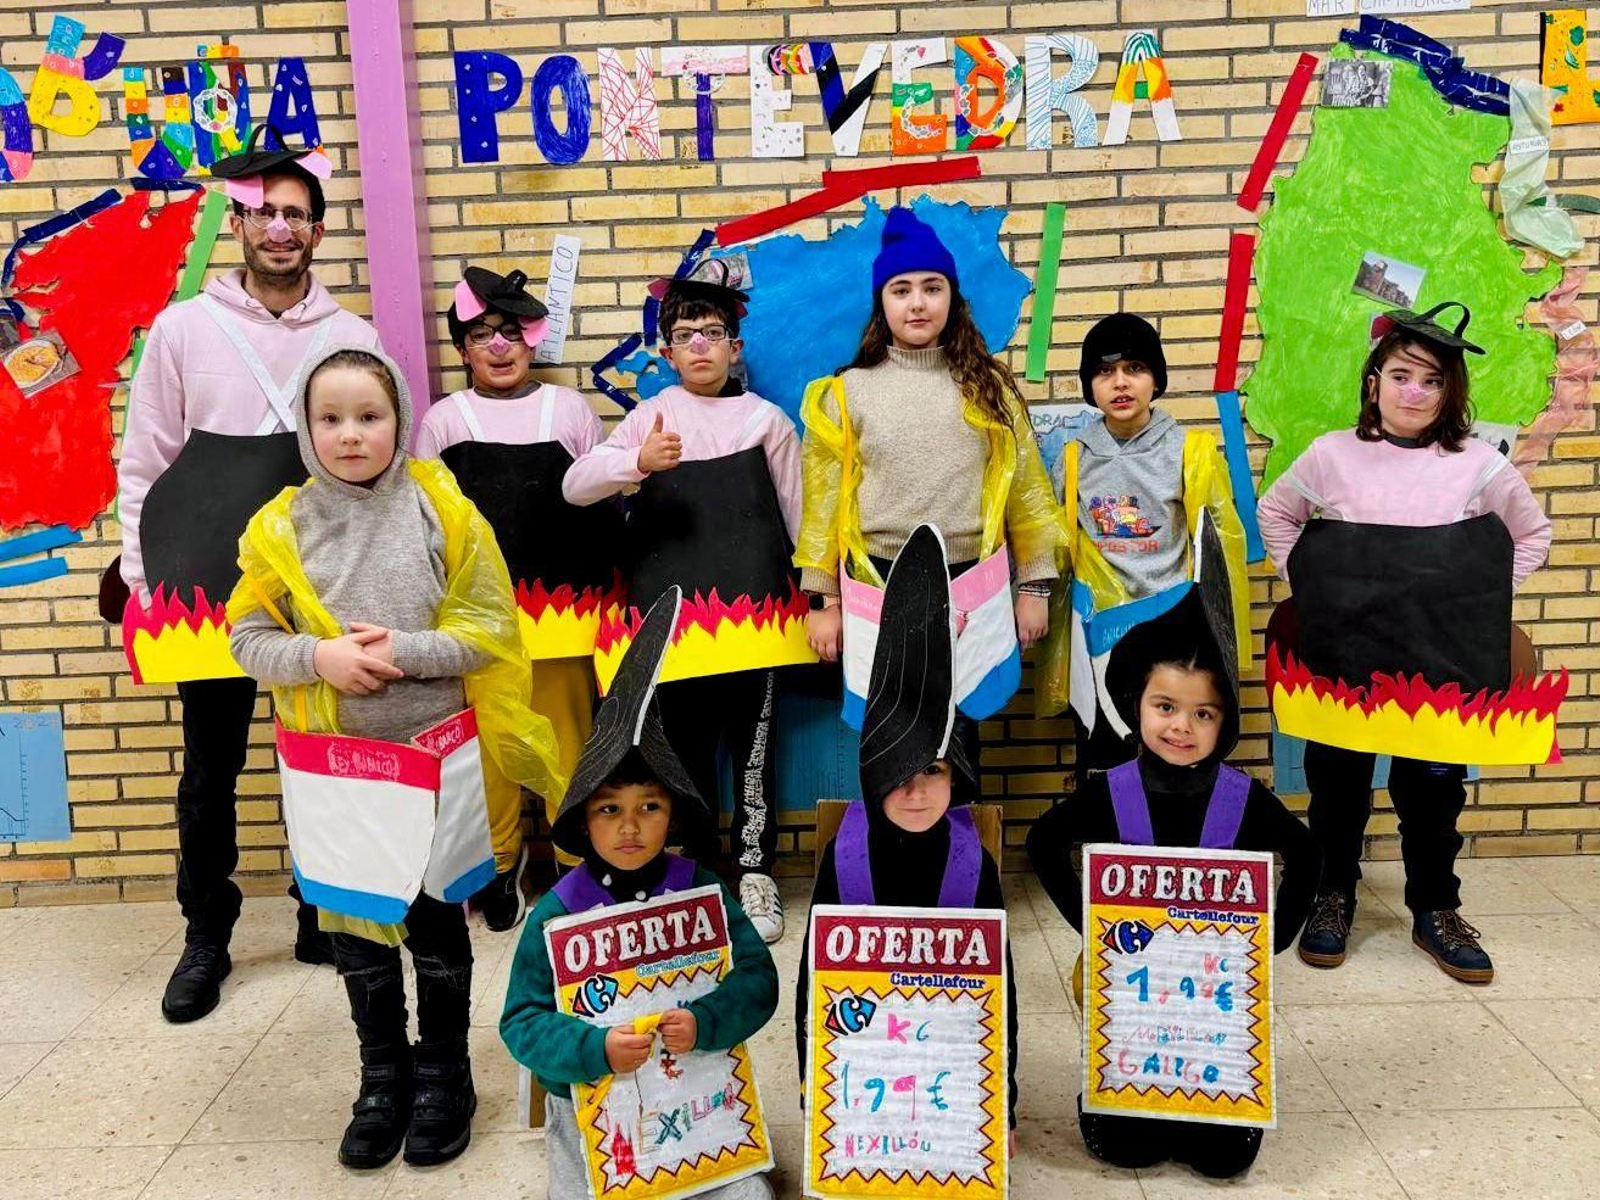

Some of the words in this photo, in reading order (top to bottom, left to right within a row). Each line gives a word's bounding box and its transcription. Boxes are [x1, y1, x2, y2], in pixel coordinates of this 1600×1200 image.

[454, 29, 1182, 164] PONTEVEDRA
[1100, 863, 1257, 904] OFERTA
[564, 905, 716, 974] OFERTA
[825, 924, 991, 966] OFERTA
